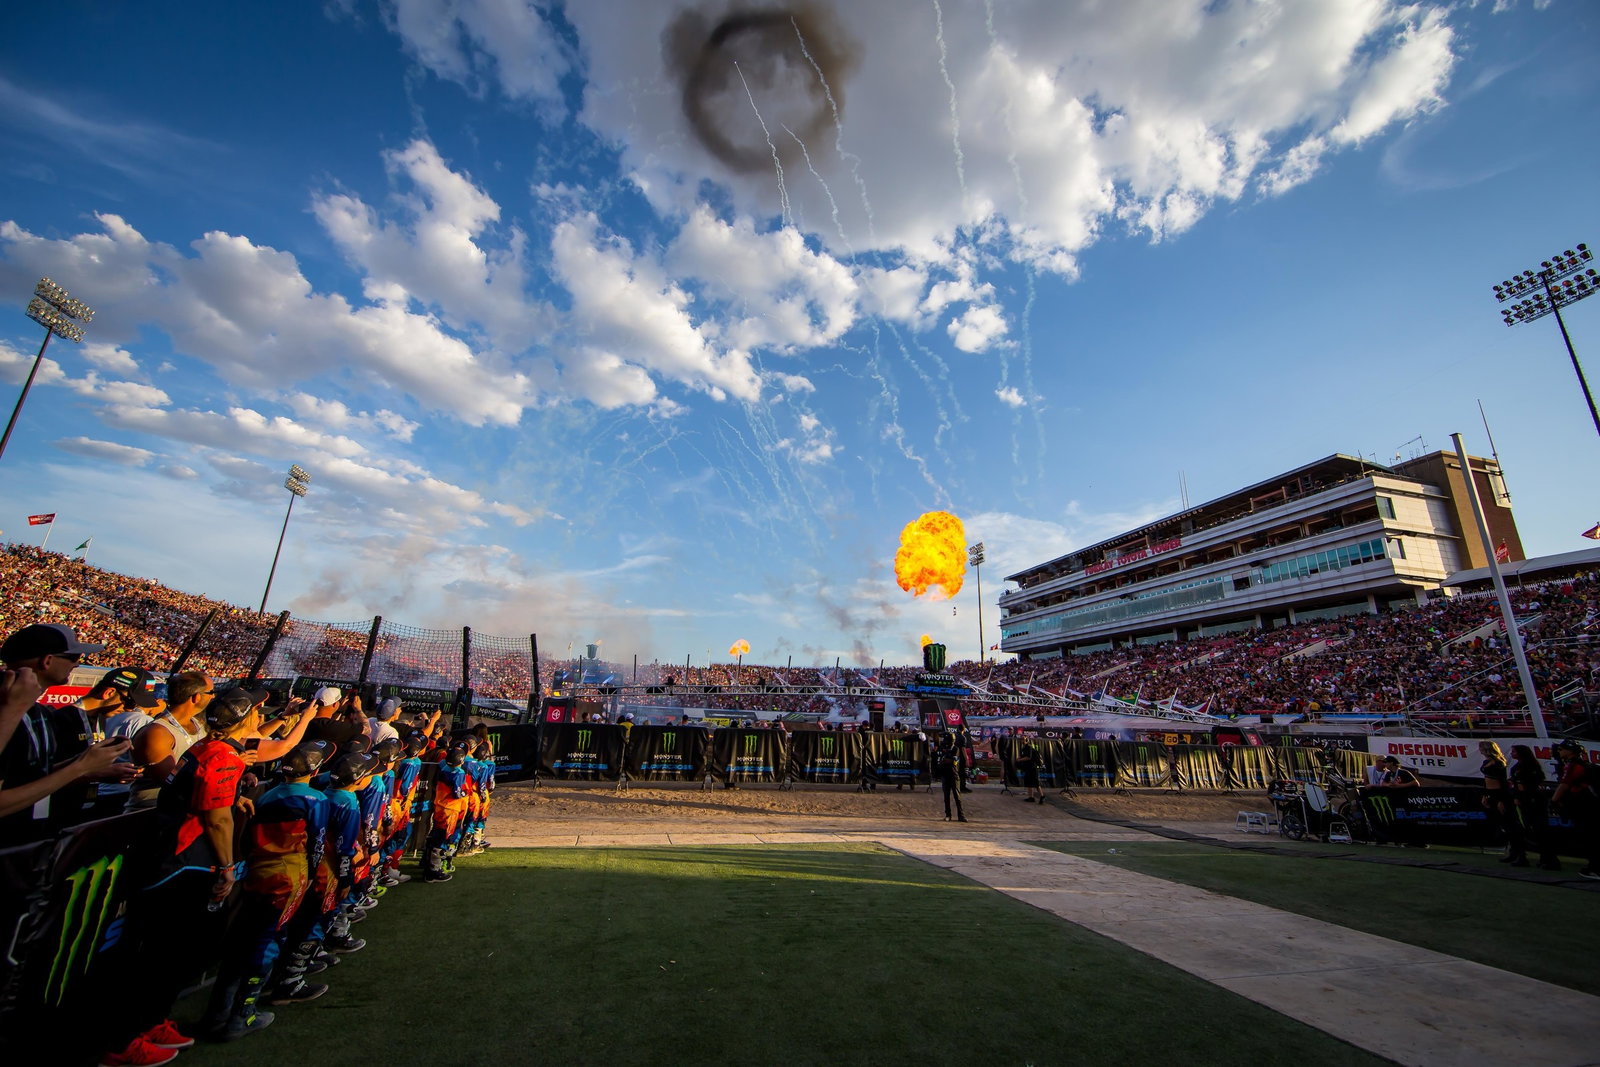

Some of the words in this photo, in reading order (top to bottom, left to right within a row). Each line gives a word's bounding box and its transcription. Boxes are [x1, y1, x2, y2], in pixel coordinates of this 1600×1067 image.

[1116, 549, 1147, 566] TOYOTA
[1150, 538, 1182, 555] TOWER
[920, 673, 955, 681] MONSTER
[401, 688, 442, 697] MONSTER
[479, 708, 506, 718] MONSTER
[1388, 743, 1467, 758] DISCOUNT
[1410, 758, 1446, 767] TIRE
[1408, 796, 1458, 805] MONSTER
